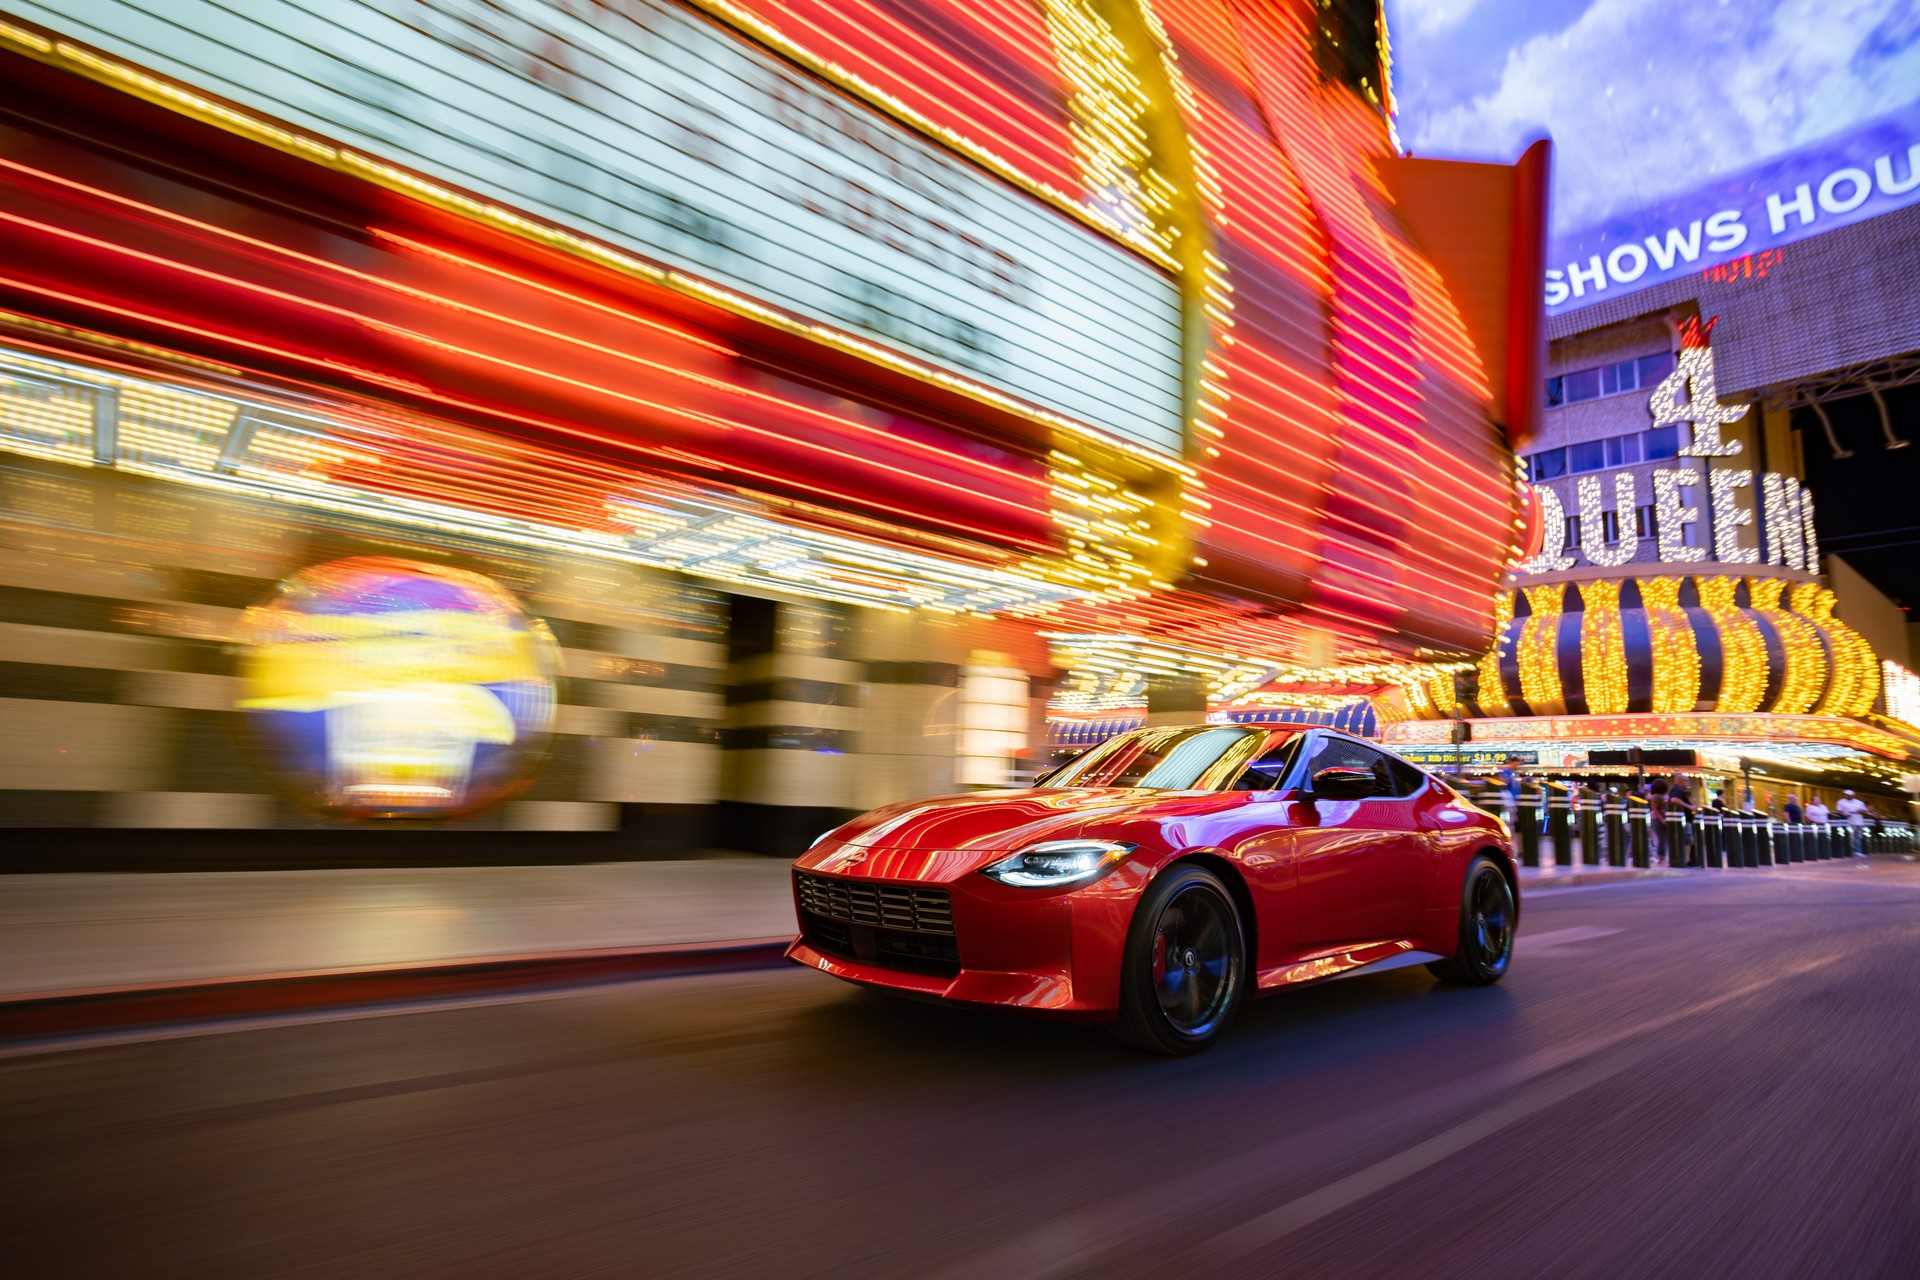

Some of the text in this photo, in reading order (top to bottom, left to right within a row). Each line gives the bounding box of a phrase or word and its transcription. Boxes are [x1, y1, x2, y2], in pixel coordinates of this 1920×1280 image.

[1544, 210, 1748, 306] SHOWS
[1650, 346, 1751, 457] 4
[1428, 754, 1442, 763] Rib
[1443, 754, 1472, 763] Diner
